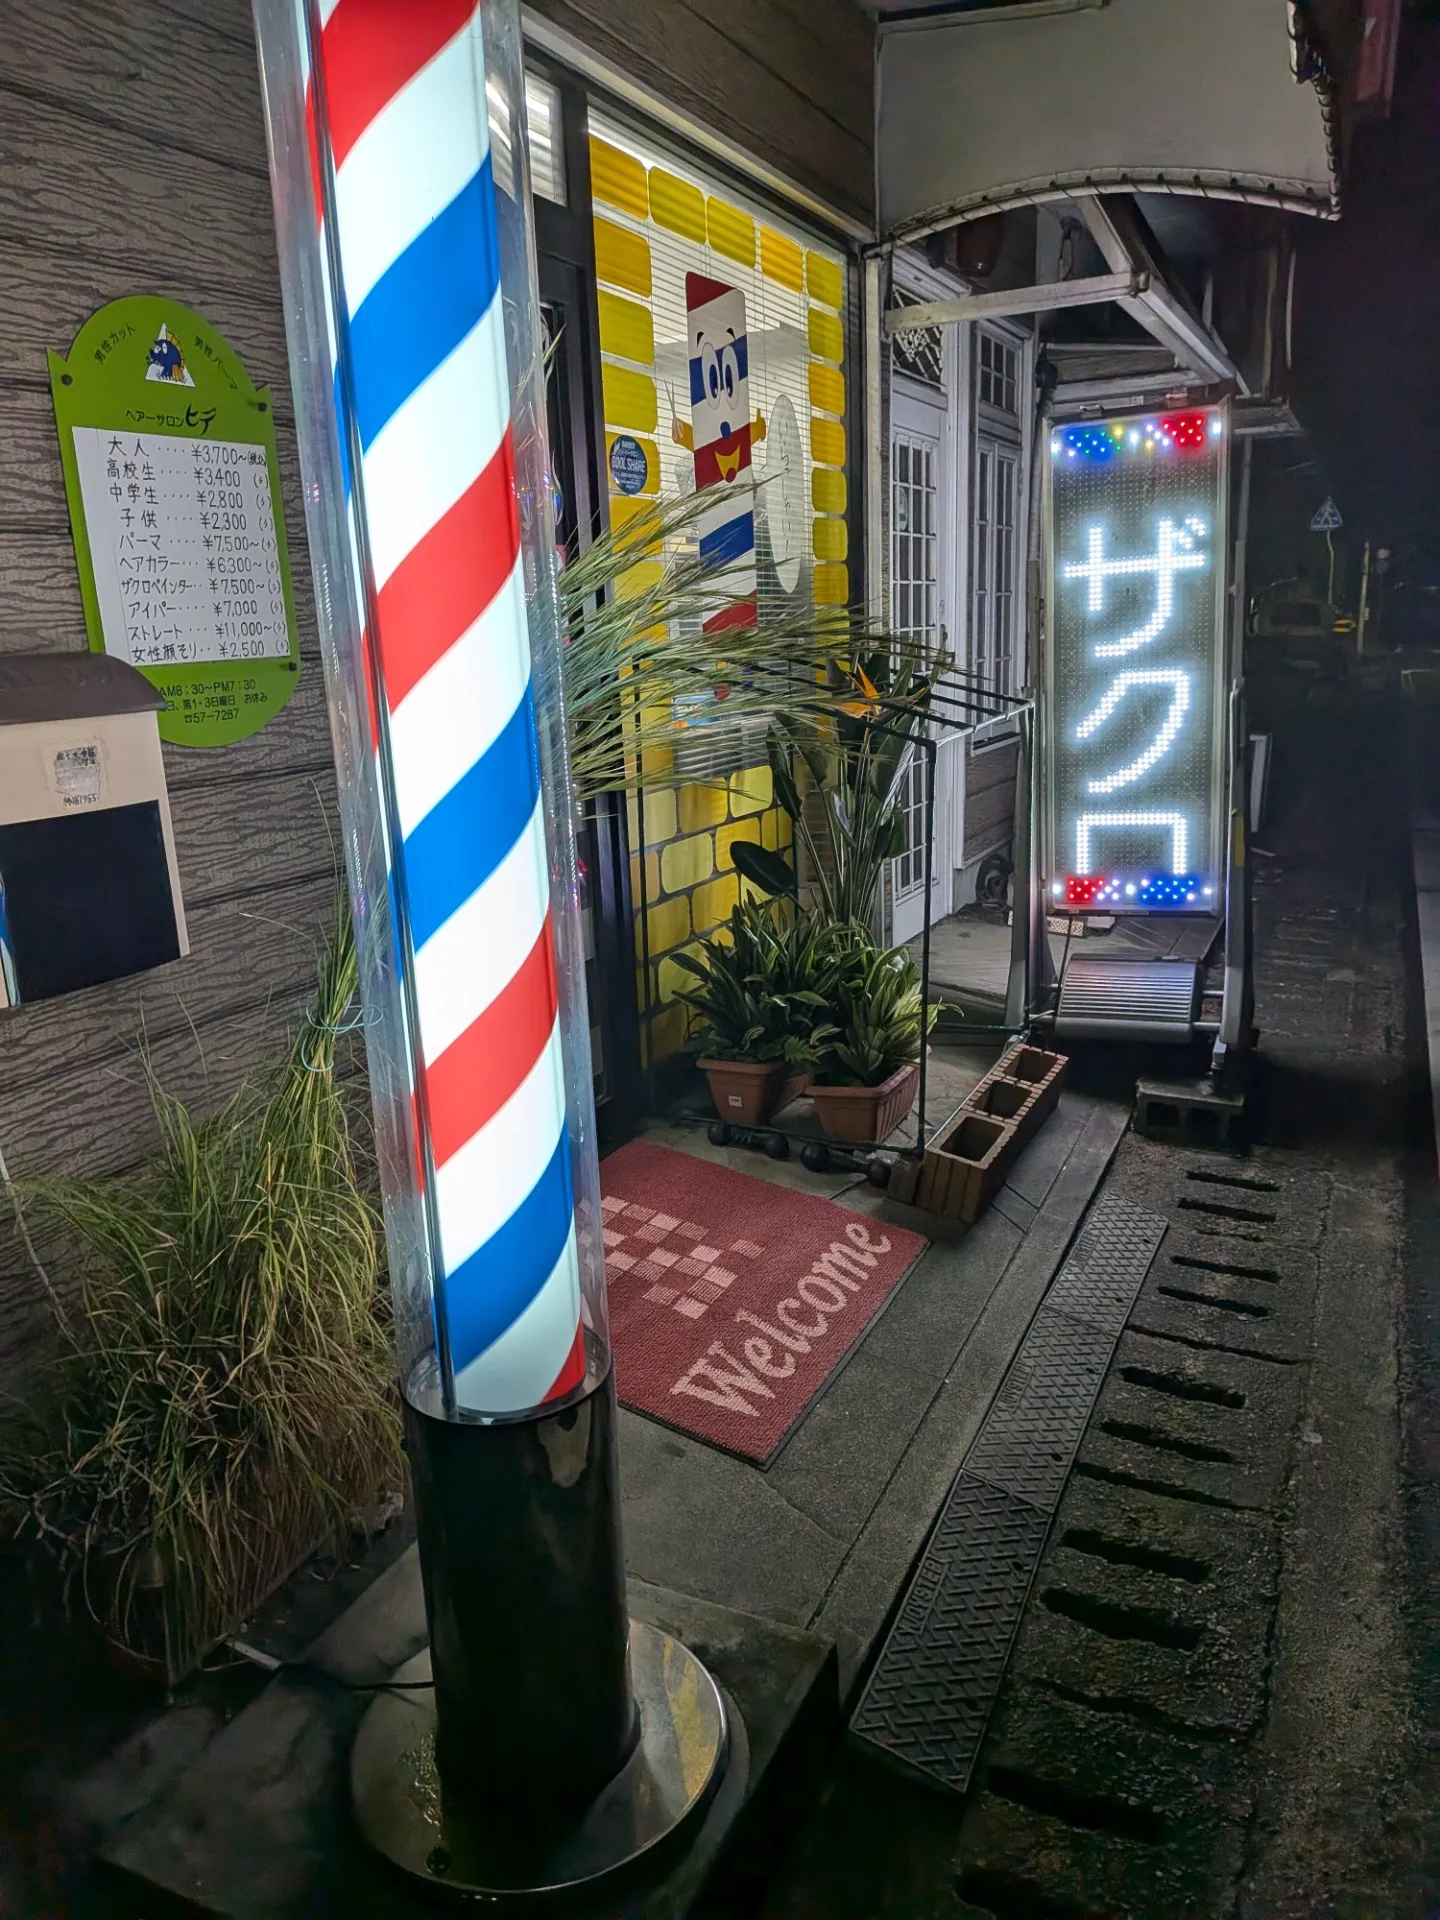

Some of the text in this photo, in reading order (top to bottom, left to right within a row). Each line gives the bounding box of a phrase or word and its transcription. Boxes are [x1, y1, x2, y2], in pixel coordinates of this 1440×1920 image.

[106, 457, 156, 481] 高校生
[193, 467, 241, 488] ¥3,400
[109, 482, 159, 505] 中学生
[197, 490, 243, 509] ¥2,800
[199, 511, 247, 530] ¥2,300
[119, 531, 161, 550] パーマ
[119, 554, 180, 574] ヘアカラー
[128, 600, 177, 620] アイパー
[212, 600, 258, 618] ¥7,000
[127, 622, 183, 642] ストレート
[131, 641, 197, 664] 女性顔そり
[218, 639, 265, 658] ¥2,500
[1063, 516, 1207, 876] ザクロ
[668, 1222, 892, 1417] Welcome
